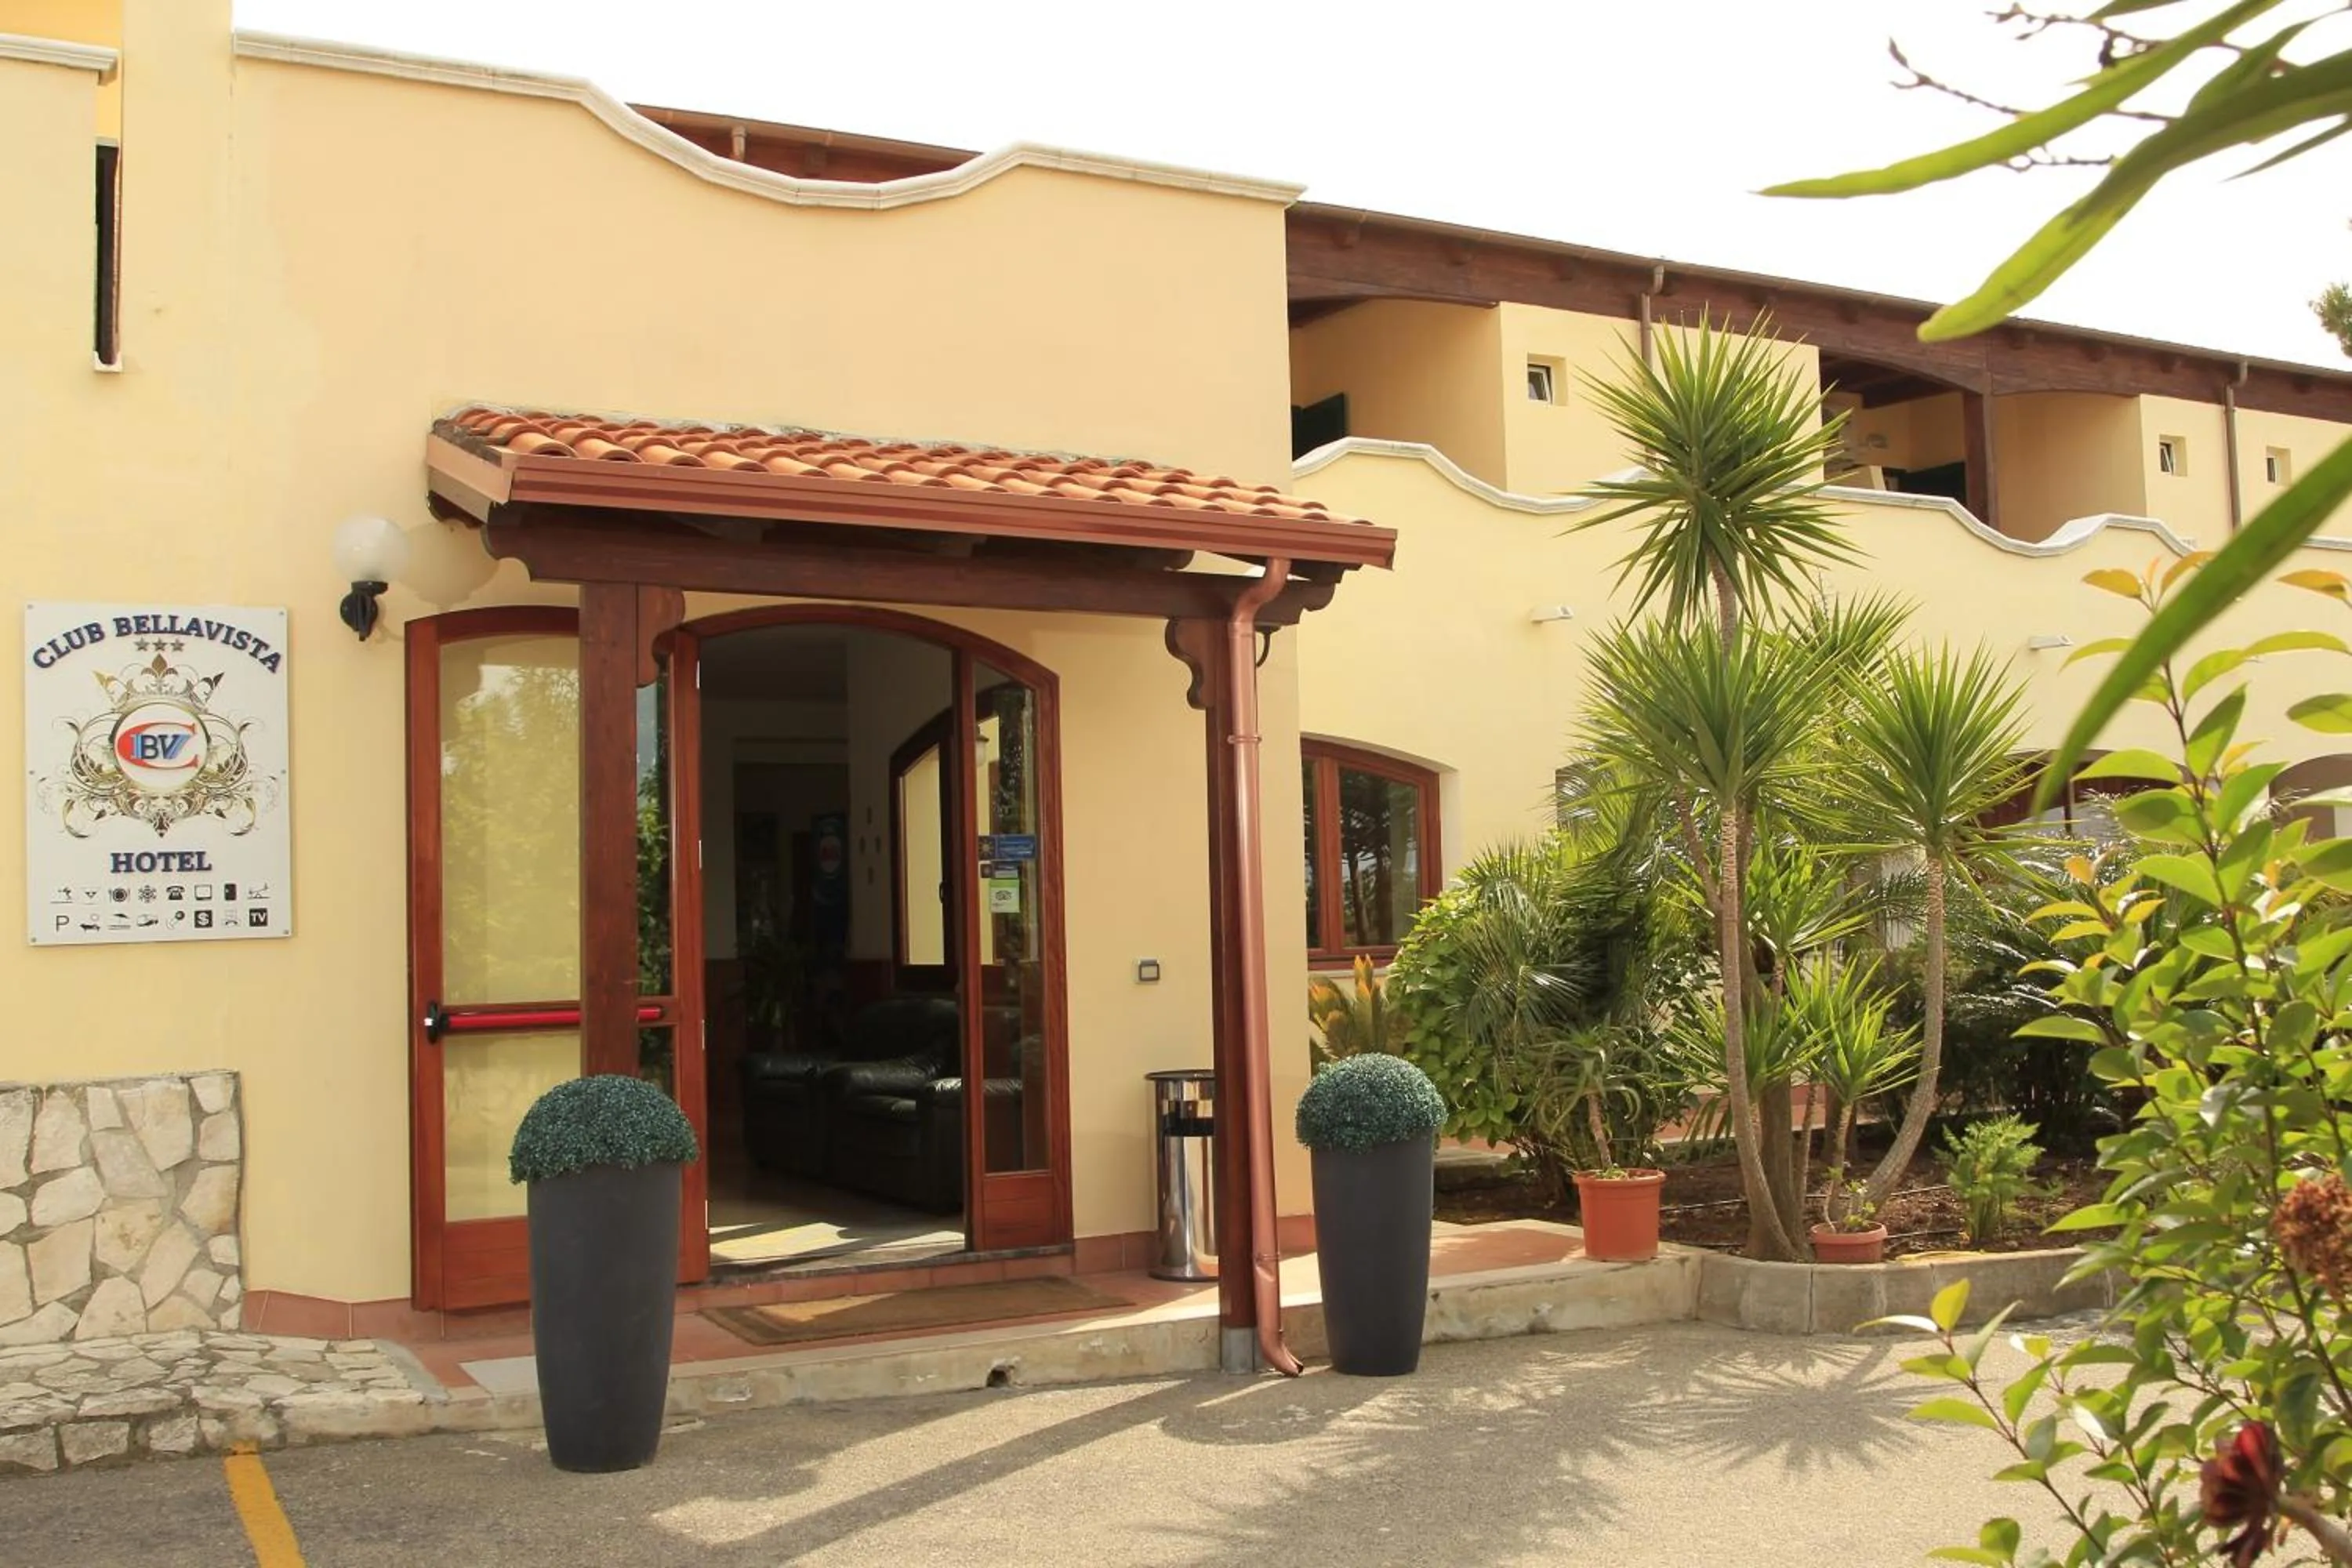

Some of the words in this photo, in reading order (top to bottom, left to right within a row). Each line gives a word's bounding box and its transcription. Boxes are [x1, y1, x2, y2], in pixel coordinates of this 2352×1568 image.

[33, 622, 105, 668] CLUB
[113, 615, 281, 673] BELLAVISTA
[111, 851, 212, 873] HOTEL
[56, 915, 70, 932] P
[251, 912, 267, 924] TV
